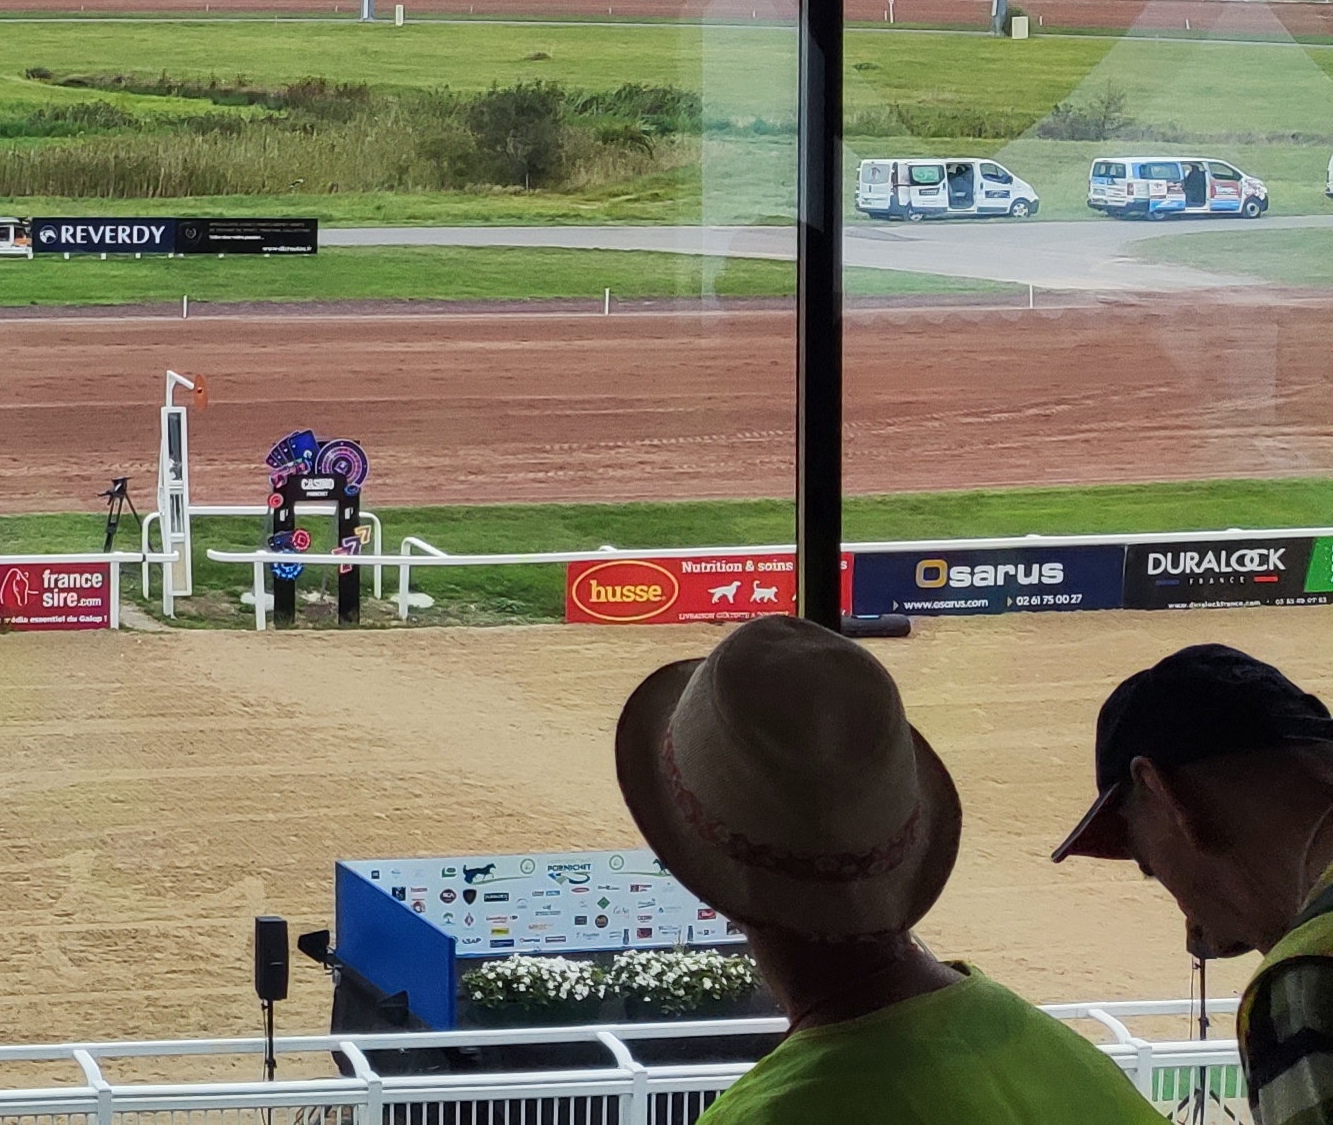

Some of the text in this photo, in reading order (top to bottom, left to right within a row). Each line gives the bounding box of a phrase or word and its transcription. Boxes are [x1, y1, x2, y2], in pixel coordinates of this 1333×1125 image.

[61, 225, 166, 244] REVERDY
[354, 524, 372, 545] 7
[681, 559, 794, 573] Nutrition & soins
[1147, 548, 1286, 575] DURALOCK
[42, 569, 103, 589] france
[915, 559, 1064, 588] Osarus
[1189, 576, 1245, 585] FRANCE
[42, 588, 102, 608] sire.com
[589, 579, 662, 603] husse
[904, 594, 1083, 611] www.osarus.com 02 61 75 00 27
[1168, 599, 1261, 609] www.duralockfrance.com
[79, 615, 103, 623] Galop
[547, 863, 592, 871] PORNICHET
